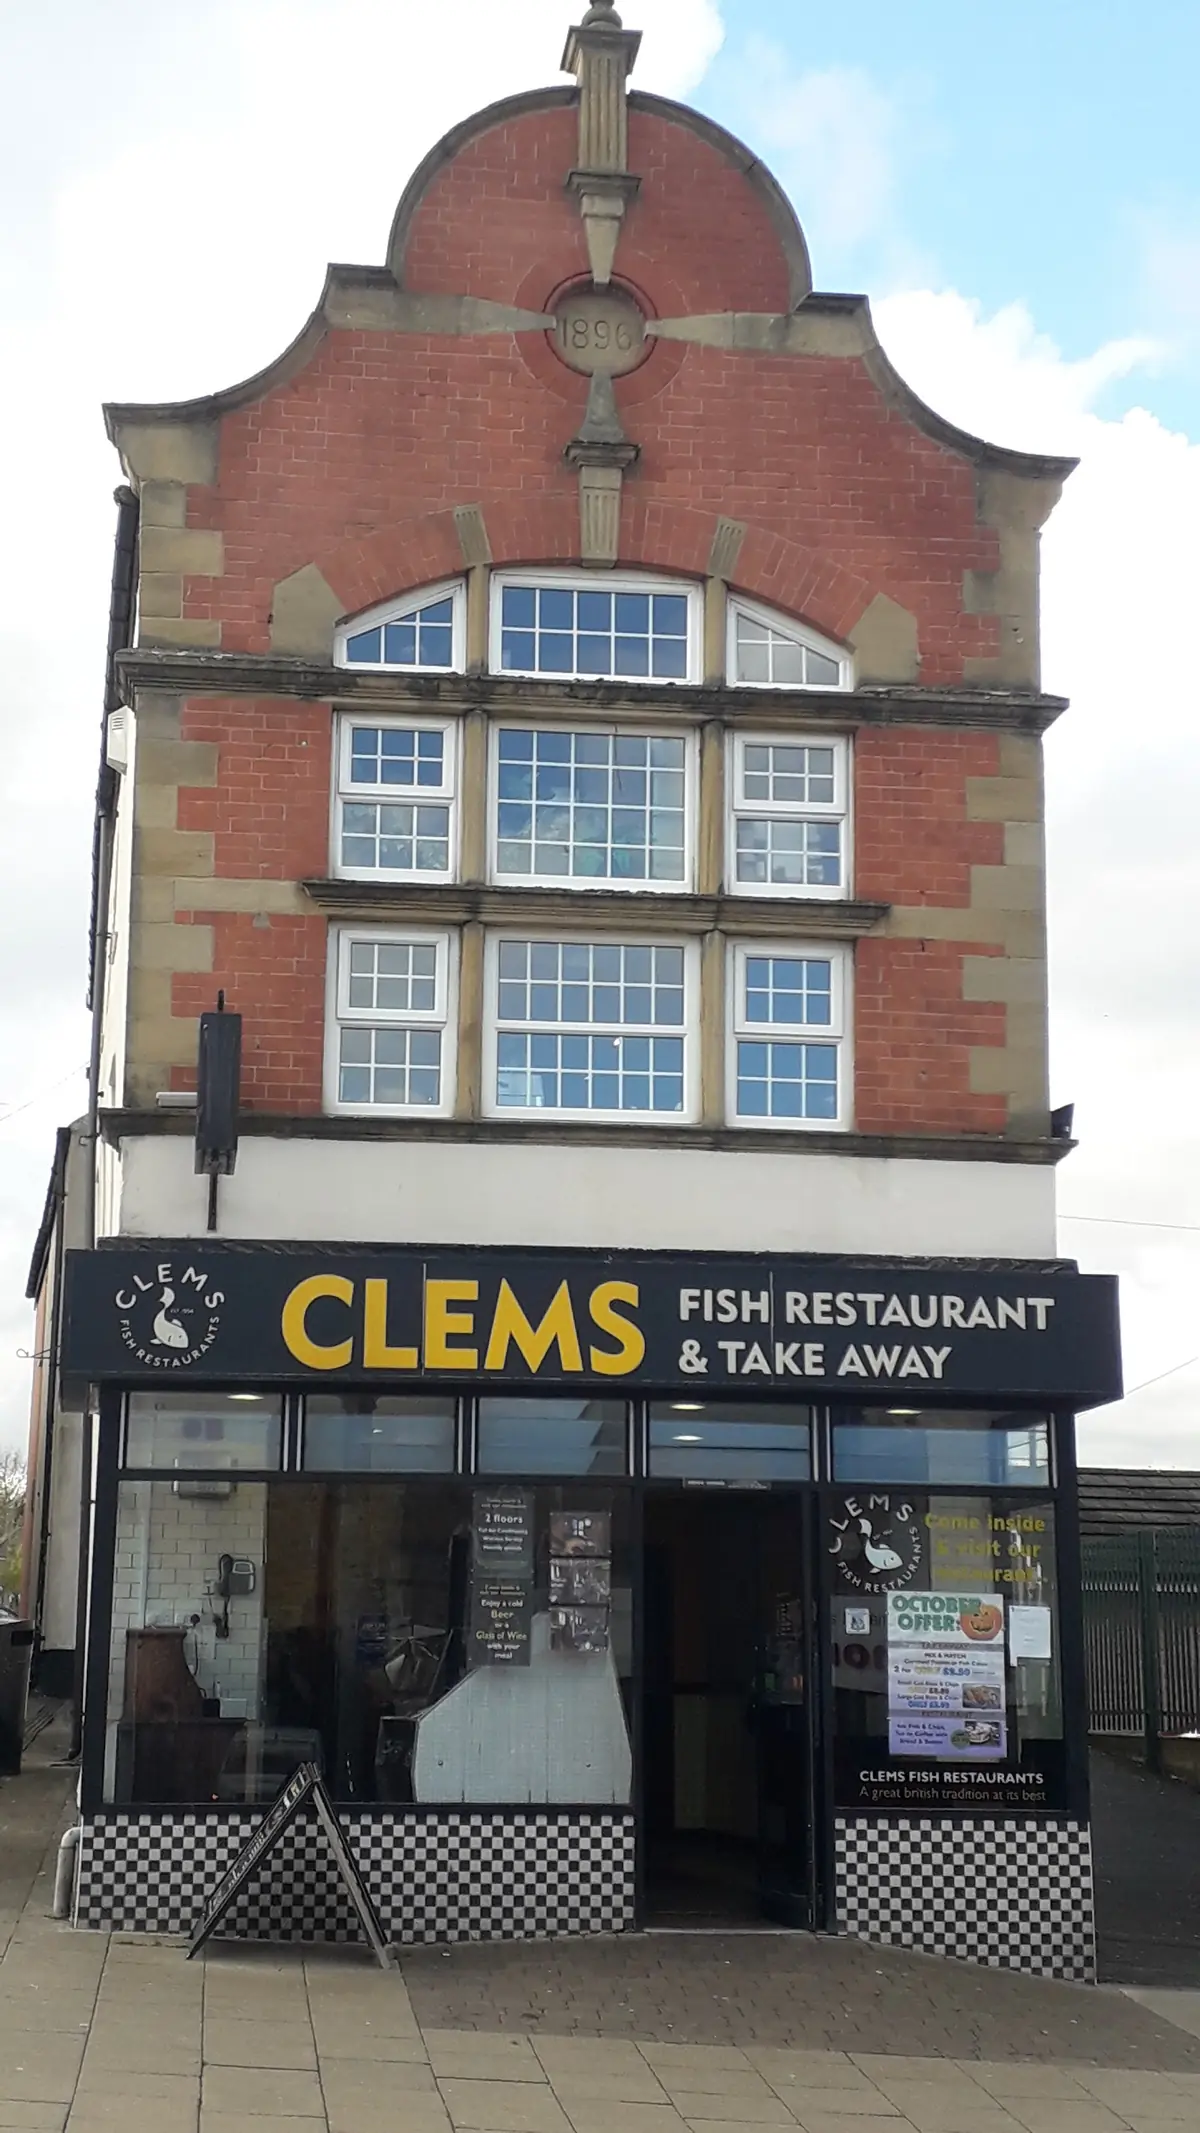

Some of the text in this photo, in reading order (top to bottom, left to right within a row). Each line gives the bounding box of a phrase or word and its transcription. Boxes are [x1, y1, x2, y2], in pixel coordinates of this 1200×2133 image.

[562, 318, 632, 350] 1896
[115, 1263, 225, 1309] CLEMS
[281, 1274, 646, 1375] CLEMS
[679, 1289, 1055, 1330] FISH RESTAURANT
[120, 1316, 220, 1368] FISH RESTAURANTS
[678, 1339, 952, 1379] & TAKE AWAY
[485, 1513, 523, 1524] 2 floors
[828, 1493, 914, 1554] CLEMS
[924, 1512, 1045, 1532] Come inside
[836, 1526, 922, 1593] FISH RESTAURANTS
[954, 1539, 1000, 1557] visit
[1007, 1544, 1042, 1558] our
[892, 1595, 983, 1614] OCTOBER
[476, 1631, 495, 1640] Glass
[859, 1770, 1044, 1785] CLEMS FISH RESTAURANTS
[859, 1786, 869, 1797] A
[872, 1787, 901, 1801] great
[904, 1787, 939, 1799] british
[942, 1788, 990, 1800] tradition
[993, 1789, 1004, 1800] at
[1022, 1790, 1046, 1801] best
